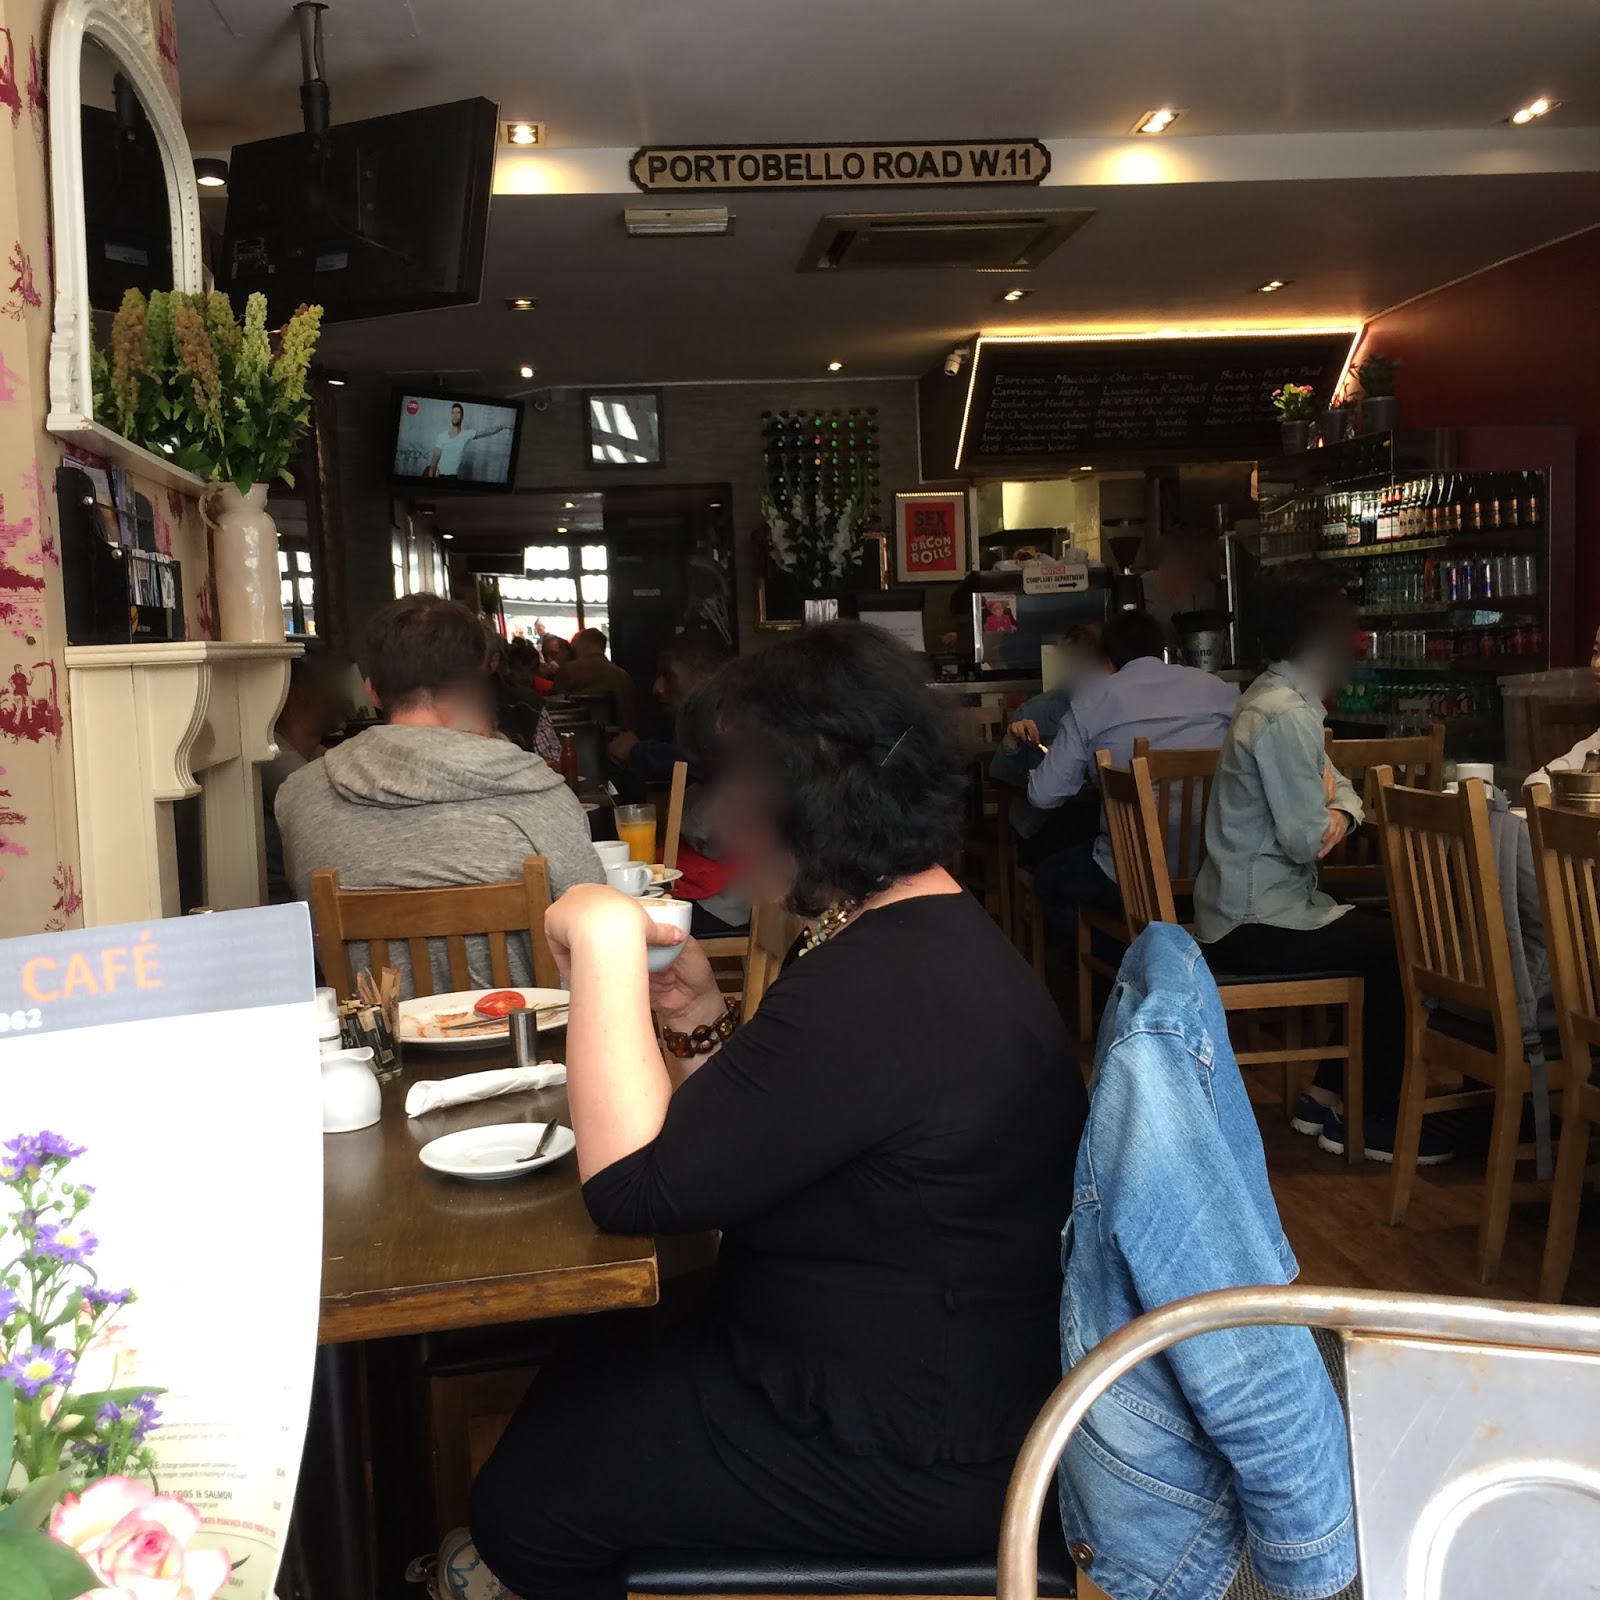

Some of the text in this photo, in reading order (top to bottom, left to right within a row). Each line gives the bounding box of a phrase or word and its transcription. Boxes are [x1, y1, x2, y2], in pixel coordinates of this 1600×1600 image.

[648, 149, 1032, 183] PORTOBELLO ROAD W.11
[914, 511, 947, 527] SEX
[911, 536, 951, 551] BACON
[911, 546, 952, 564] ROLLS
[1026, 574, 1085, 584] COMPLAINT DEPARTMENT
[21, 928, 164, 1003] CAFÉ
[204, 1490, 233, 1500] SALMON
